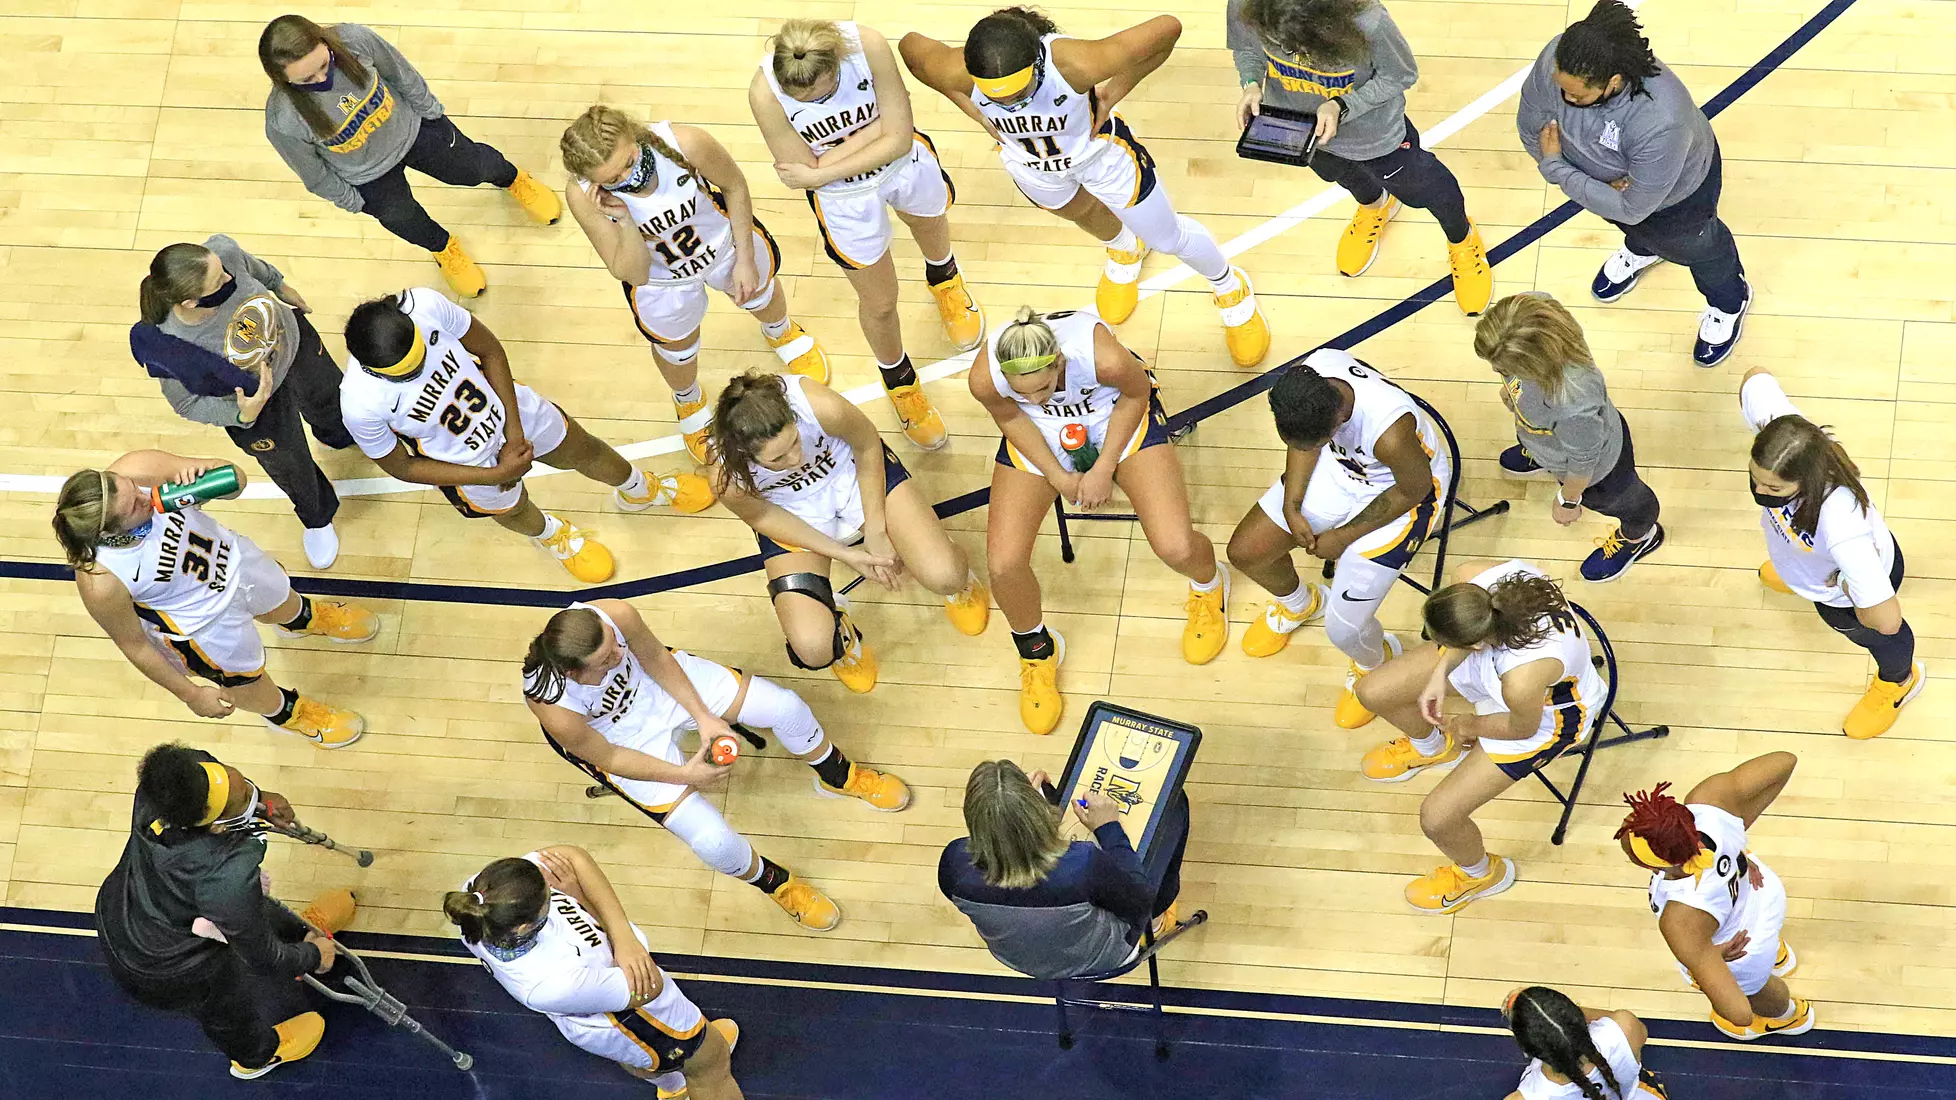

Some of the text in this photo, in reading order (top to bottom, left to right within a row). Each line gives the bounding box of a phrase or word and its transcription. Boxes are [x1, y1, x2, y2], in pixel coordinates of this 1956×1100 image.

[800, 102, 874, 143] MURRAY
[988, 113, 1068, 133] MURRAY
[1017, 136, 1062, 158] 11
[638, 196, 697, 236] URRAY
[654, 225, 702, 265] 12
[669, 245, 717, 279] STATE
[407, 349, 460, 423] MURRAY
[438, 376, 488, 437] 23
[1041, 400, 1095, 417] STATE
[464, 404, 502, 450] STATE
[181, 530, 214, 583] 31
[208, 540, 231, 593] STATE
[1112, 715, 1174, 739] MURRAY STATE
[1089, 766, 1108, 795] RACE
